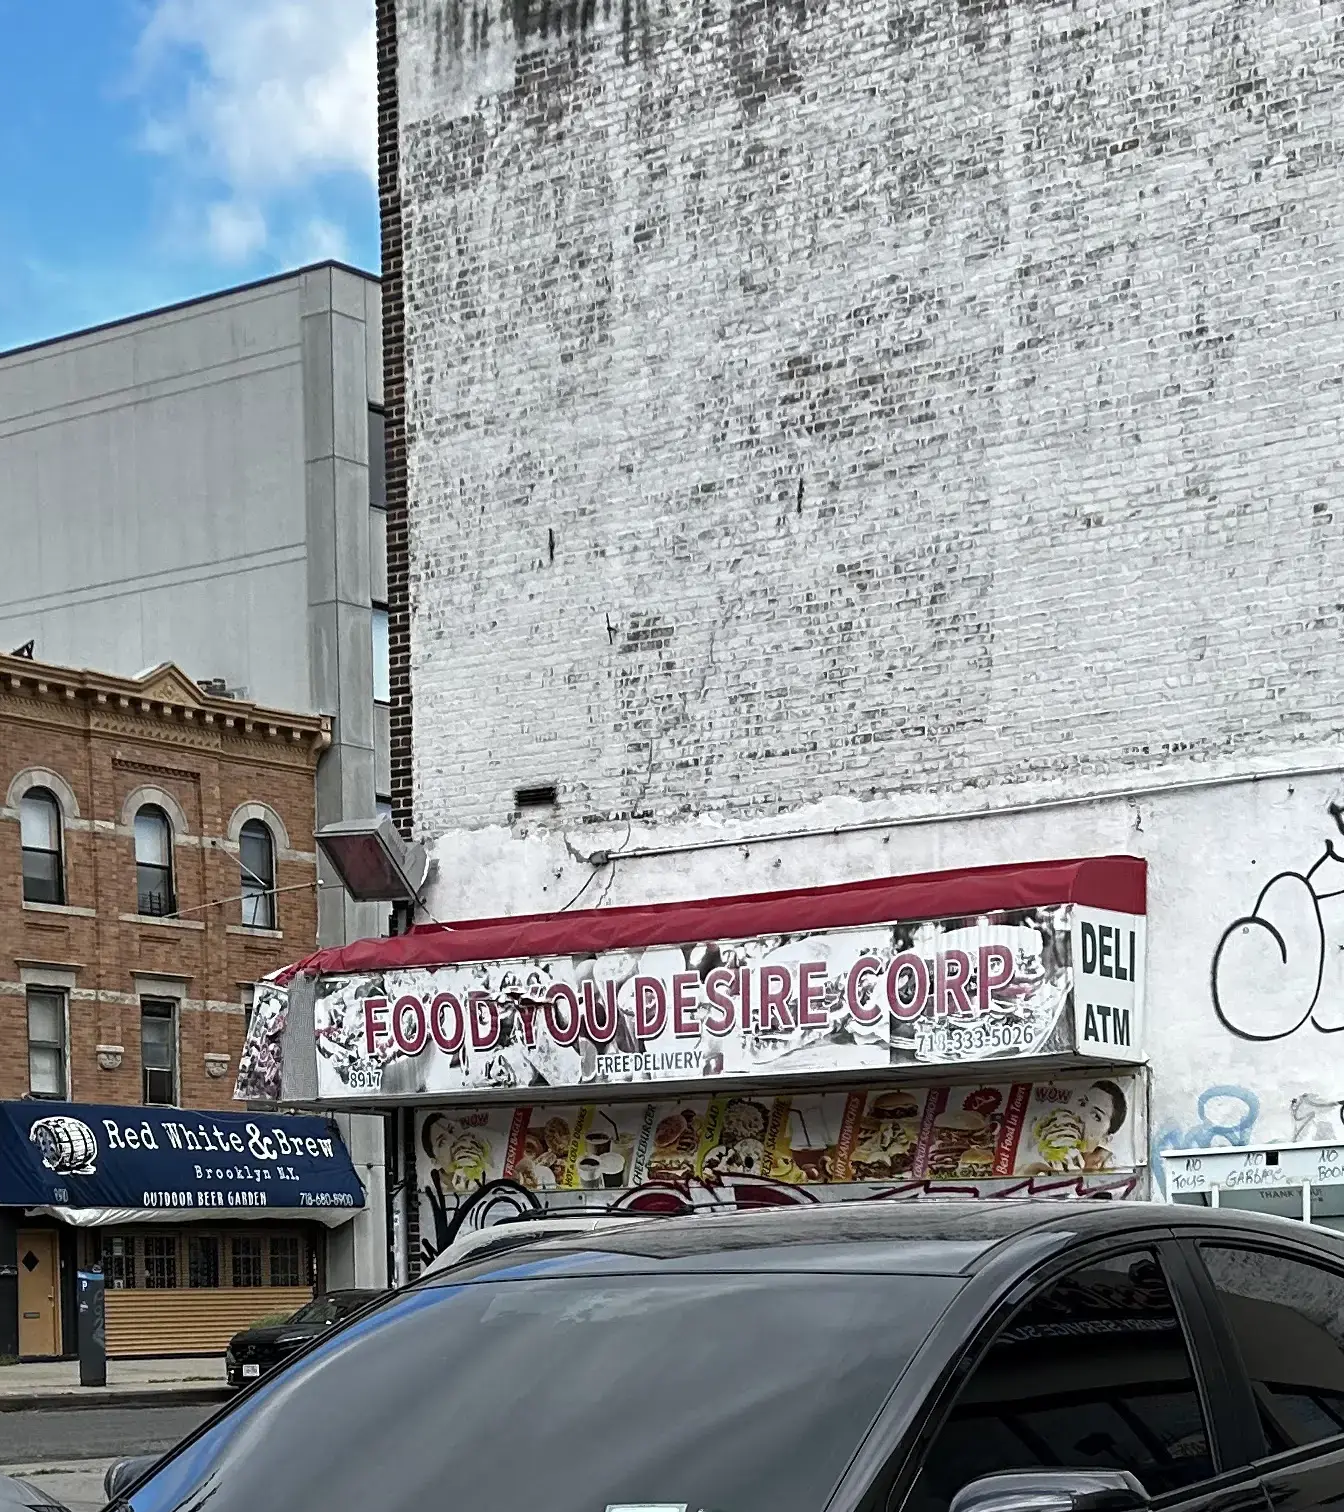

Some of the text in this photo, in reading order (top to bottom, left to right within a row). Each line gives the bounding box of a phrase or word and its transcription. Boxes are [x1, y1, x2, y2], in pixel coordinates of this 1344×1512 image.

[1081, 921, 1136, 983] DELI
[364, 945, 1016, 1056] FOOD YOU DESIRE CORP
[1084, 1003, 1131, 1047] ATM
[916, 1025, 1034, 1053] 718-333-5026
[596, 1049, 703, 1075] FREE DELIVERY
[349, 1069, 382, 1088] 8917
[1012, 1086, 1025, 1112] Town
[1035, 1087, 1072, 1104] WOW
[705, 1105, 719, 1142] SALAD
[102, 1119, 335, 1160] Red White & Brew
[633, 1104, 656, 1186] CHEESEBURGER
[1002, 1127, 1015, 1151] Food
[506, 1145, 519, 1176] FRESH
[570, 1141, 580, 1163] COLD
[762, 1151, 773, 1176] RESH
[997, 1153, 1009, 1175] Best
[1244, 1153, 1263, 1166] NO
[1319, 1149, 1338, 1162] NO
[194, 1164, 271, 1182] Brooklyn
[835, 1156, 846, 1179] HOT
[1186, 1159, 1201, 1171] NO
[143, 1191, 267, 1207] OUTDOOR BEER GARDEN
[1259, 1190, 1294, 1198] THANK
